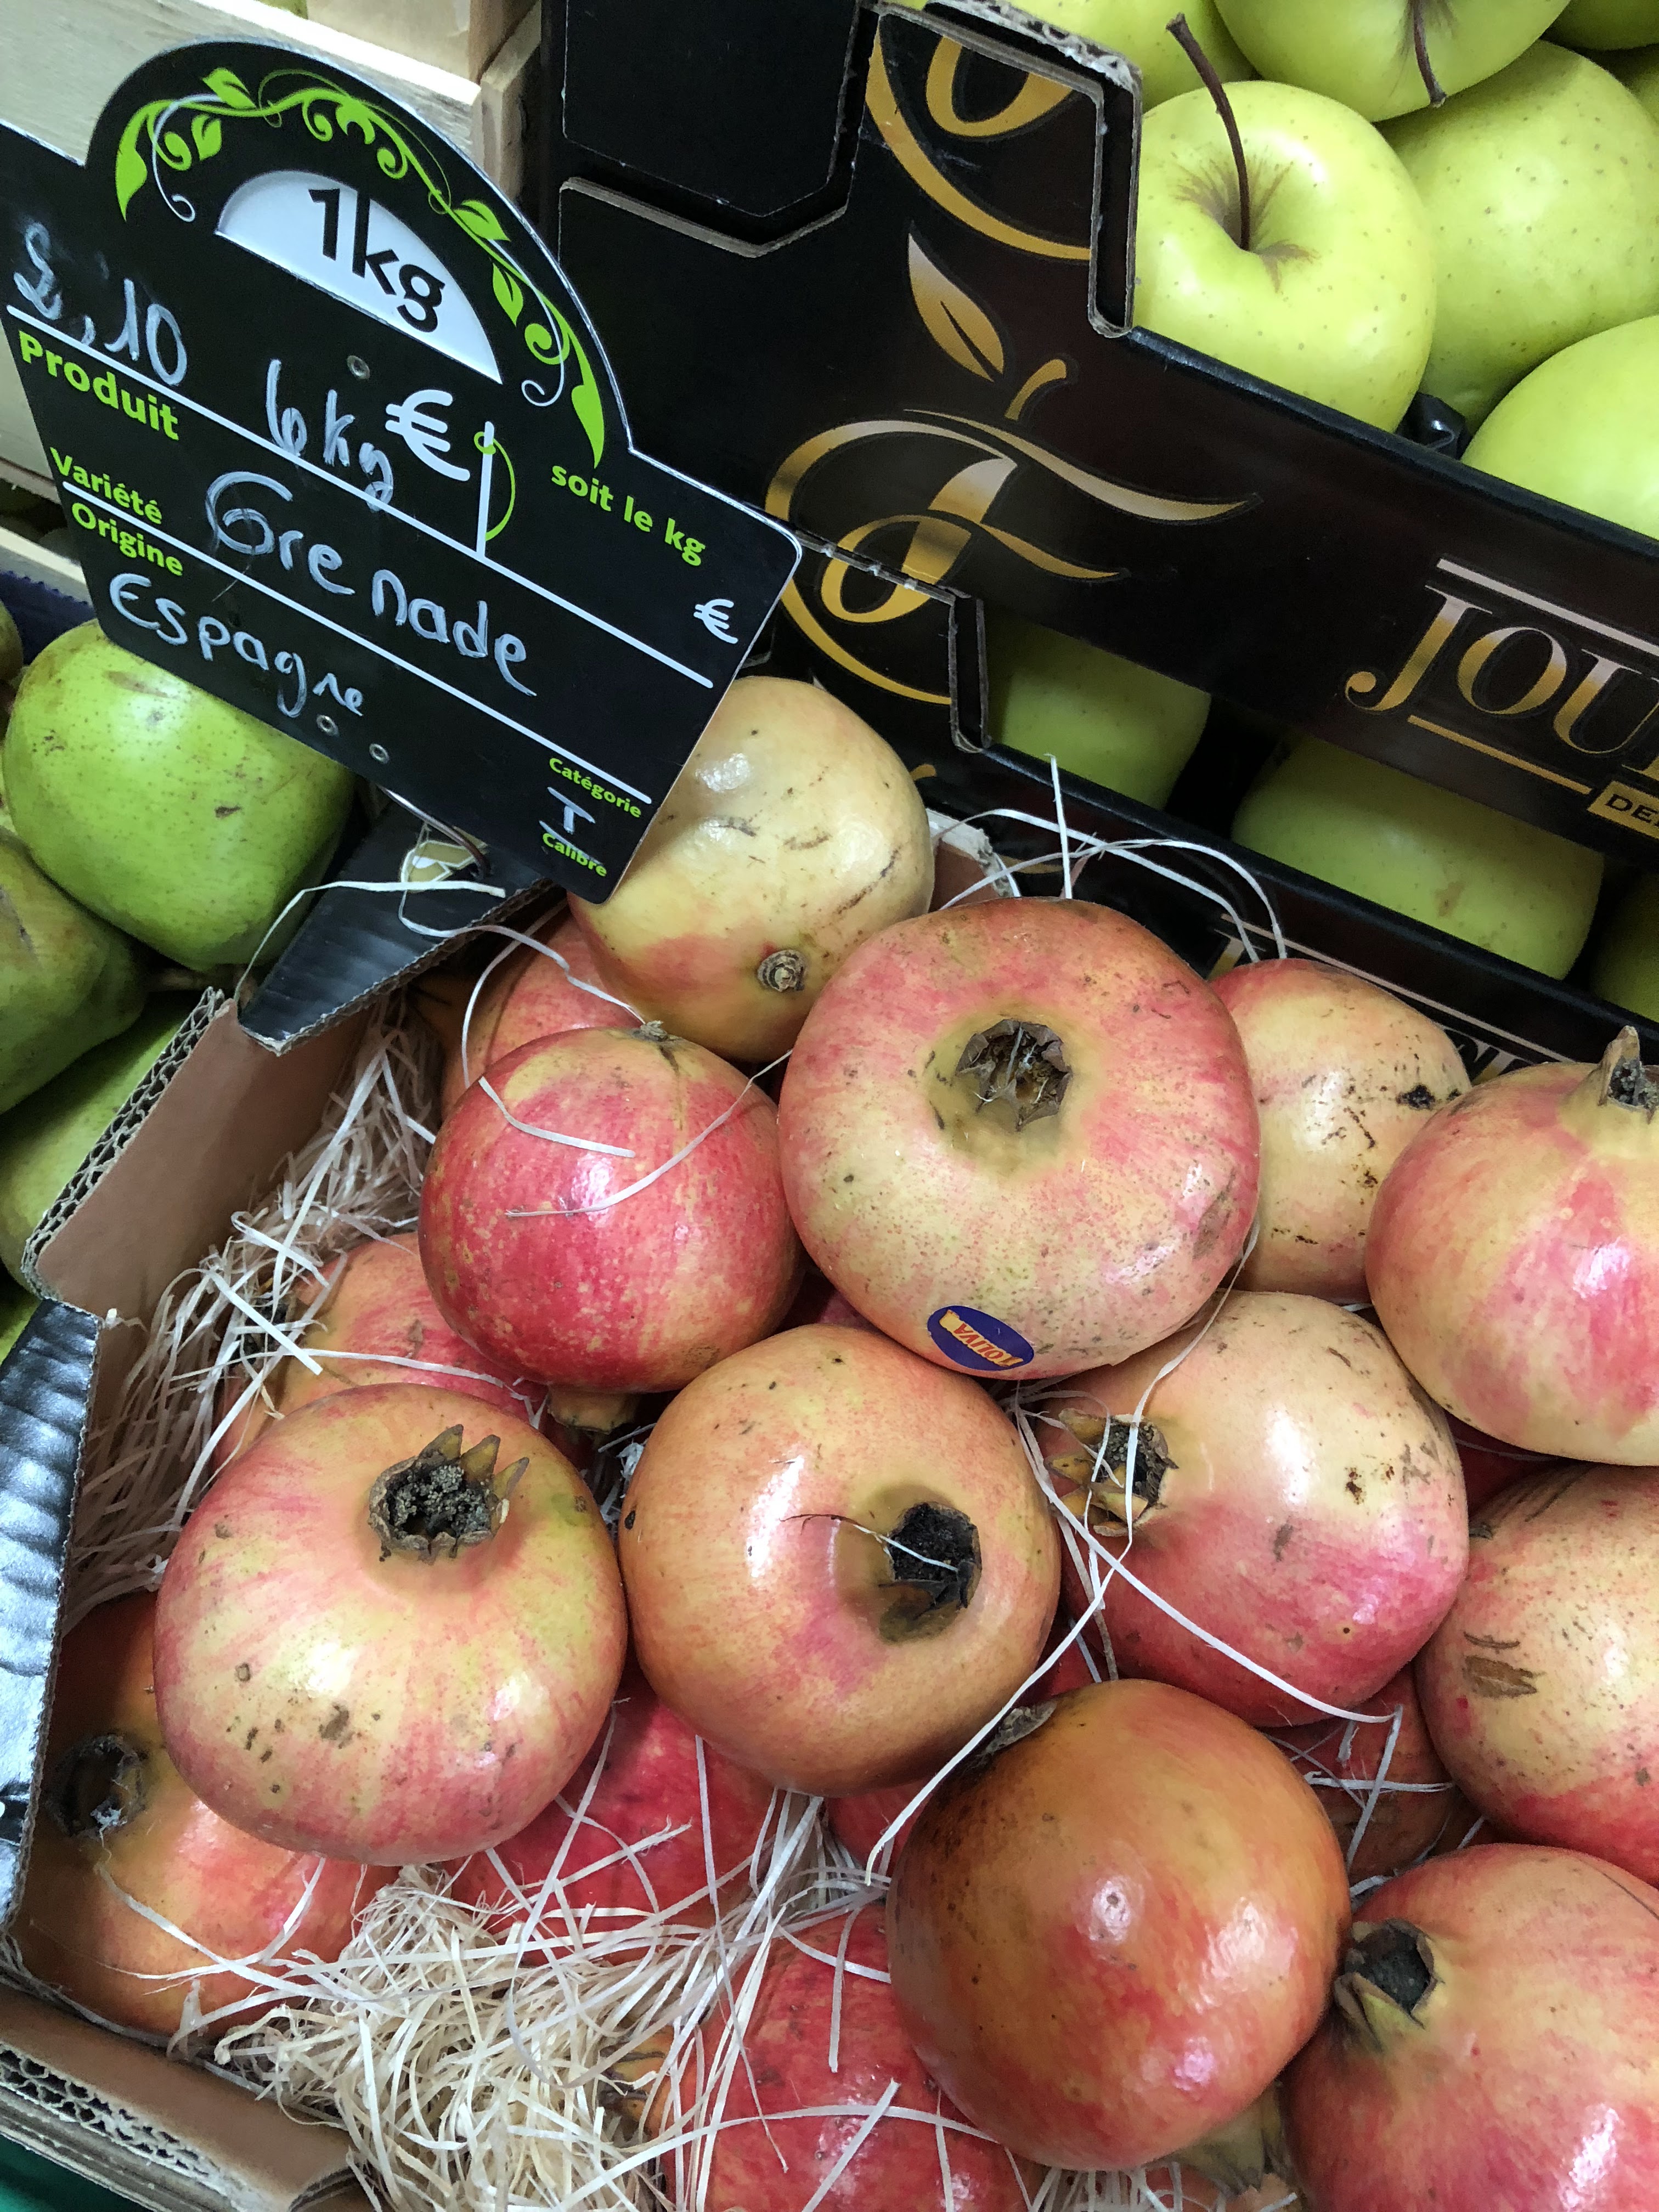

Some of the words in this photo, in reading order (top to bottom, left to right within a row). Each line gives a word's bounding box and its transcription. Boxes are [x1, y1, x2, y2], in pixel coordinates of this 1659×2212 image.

[309, 188, 445, 332] 1kg
[19, 330, 179, 441] Produit
[50, 447, 162, 524] Variété
[552, 464, 613, 512] soit
[624, 496, 653, 532] le
[665, 518, 706, 566] kg
[72, 503, 183, 576] Origine
[110, 573, 363, 717] Espagne
[693, 599, 738, 644] €
[1345, 585, 1659, 781] JOU
[549, 758, 641, 818] Catégorie
[1604, 794, 1659, 827] DE
[543, 833, 607, 877] Calibre
[953, 1323, 1004, 1359] OLIVA
